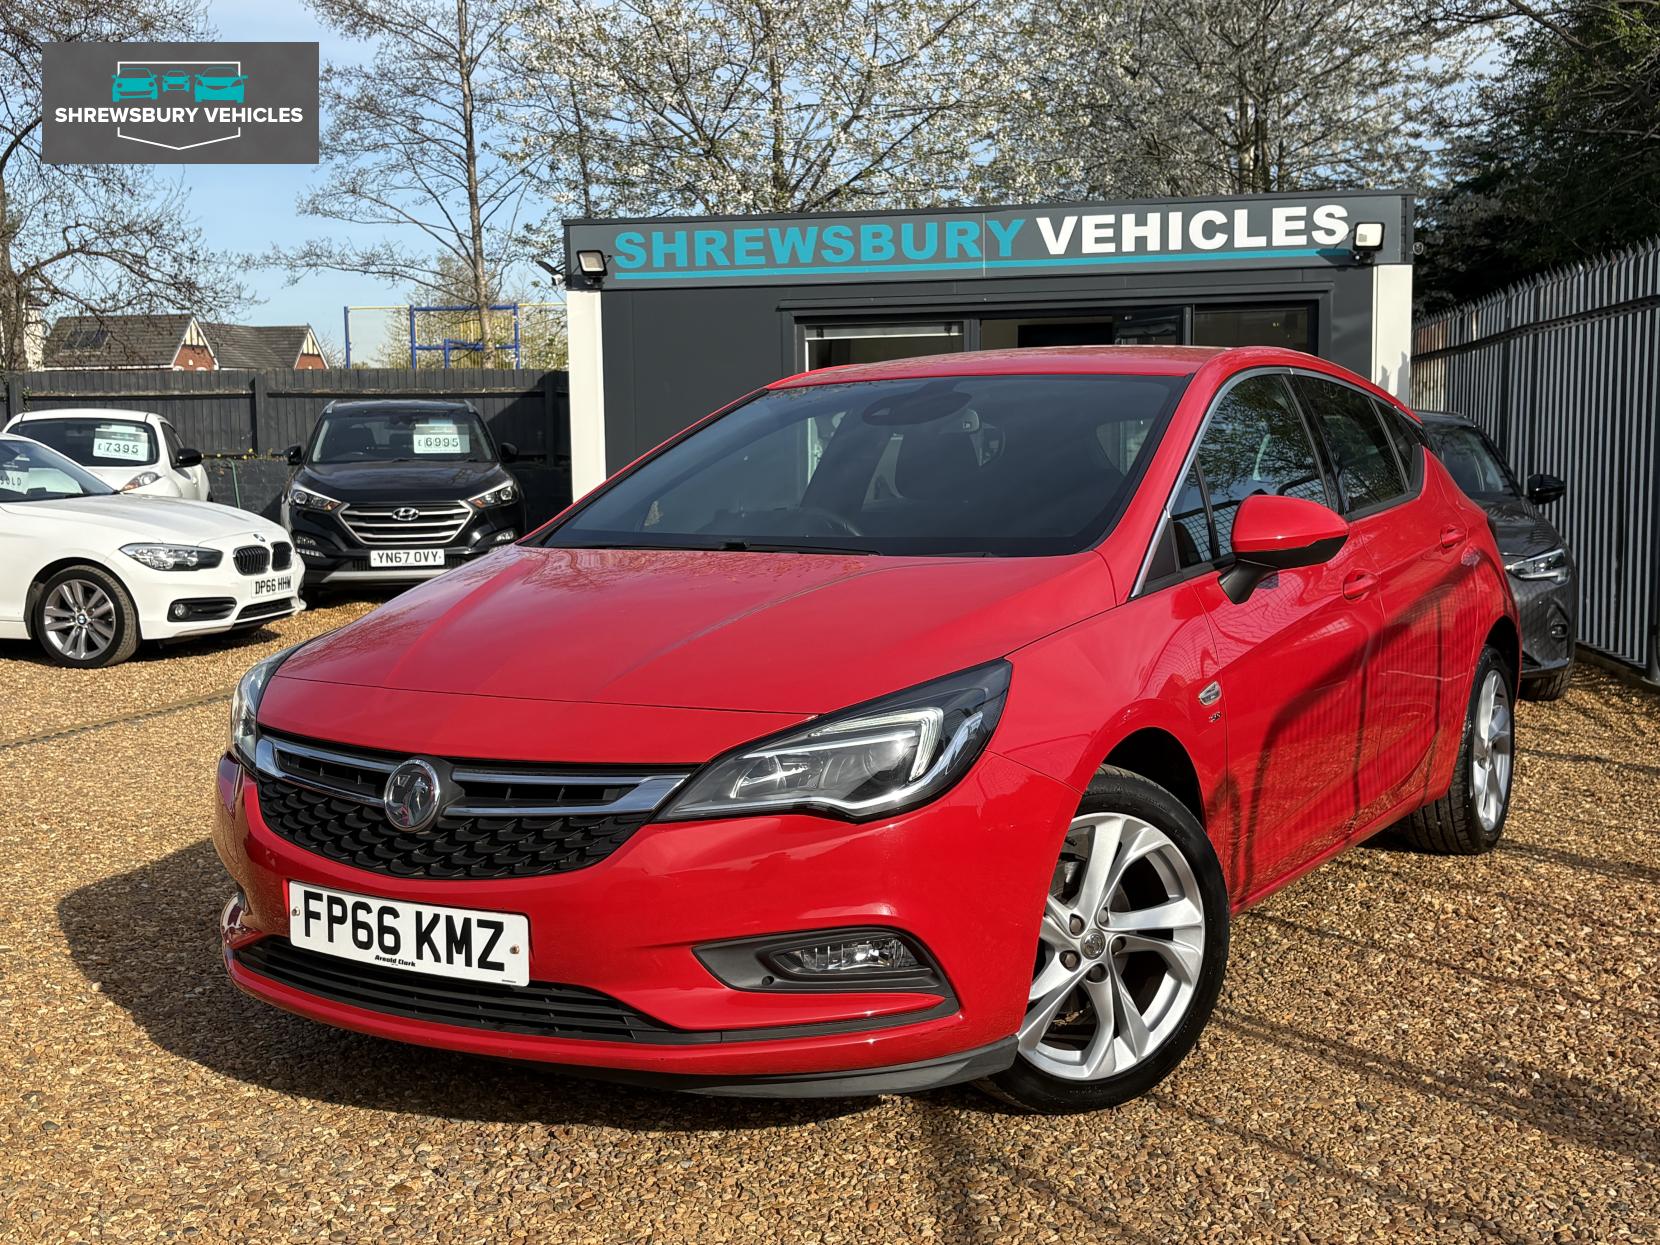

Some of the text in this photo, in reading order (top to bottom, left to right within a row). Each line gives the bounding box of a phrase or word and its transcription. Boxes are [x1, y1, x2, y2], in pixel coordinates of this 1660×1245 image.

[614, 204, 1349, 269] SHREWSBURY VEHICLES
[377, 550, 438, 564] YN67 OVY
[255, 578, 277, 595] DP66
[303, 889, 505, 972] FP66 KMZ
[375, 954, 417, 967] Arnold Clark
